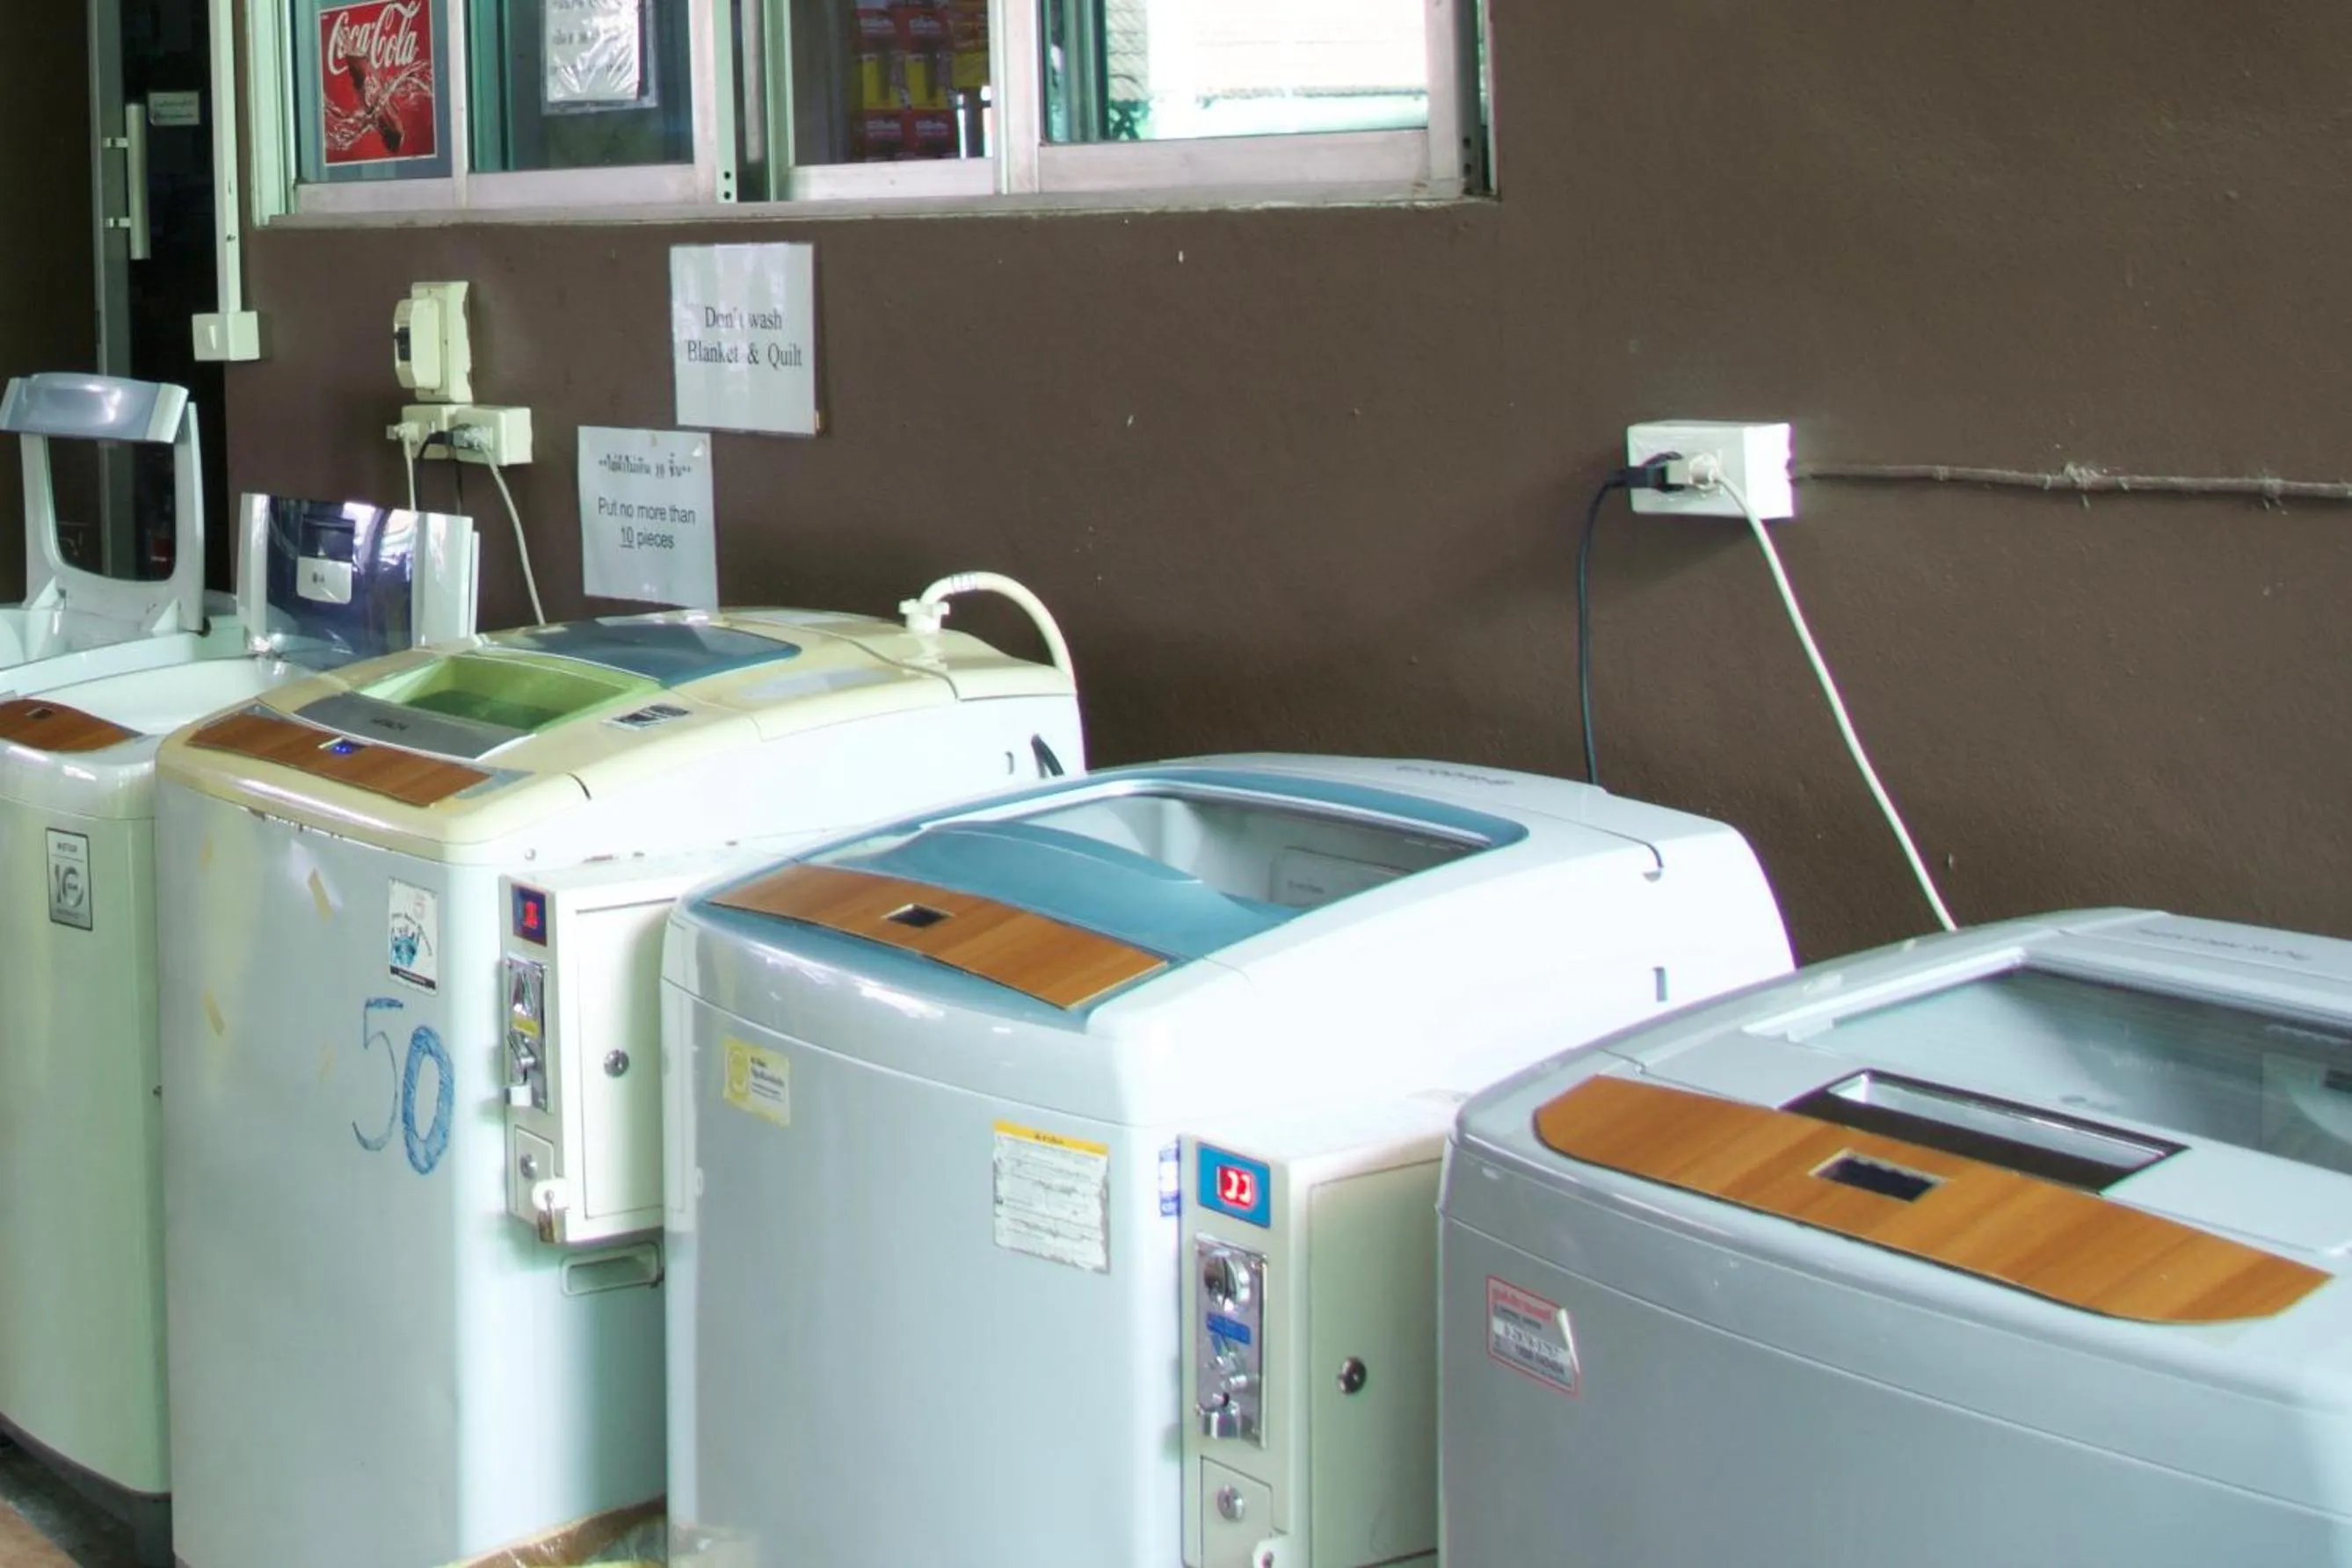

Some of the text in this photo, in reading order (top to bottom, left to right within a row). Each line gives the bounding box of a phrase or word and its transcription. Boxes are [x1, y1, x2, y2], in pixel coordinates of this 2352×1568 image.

[748, 309, 783, 330] wash
[686, 339, 802, 372] Blanket & Quilt
[598, 496, 696, 525] Put no more than
[621, 526, 675, 549] 10 pieces
[352, 997, 455, 1175] 50
